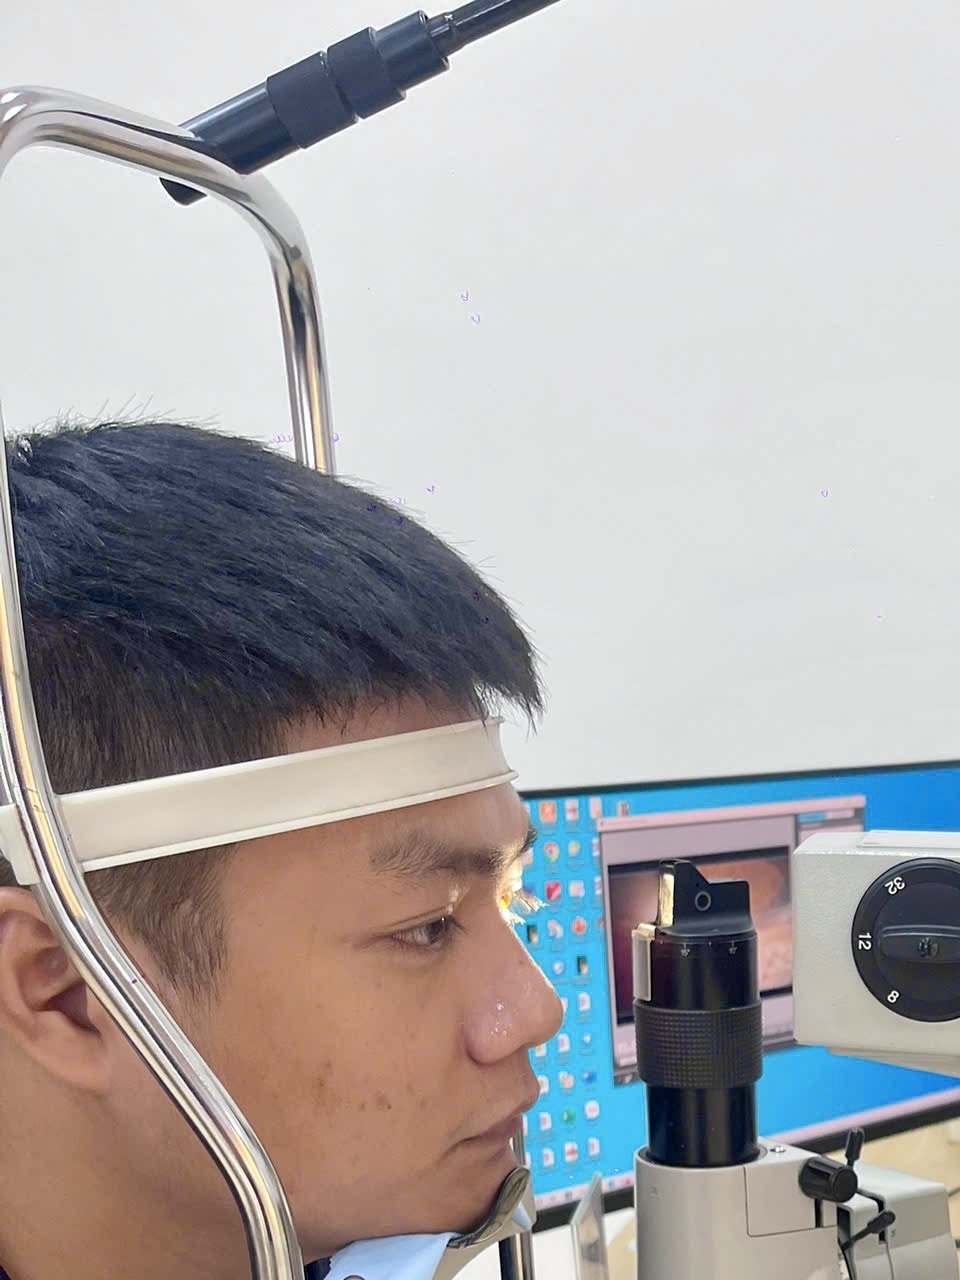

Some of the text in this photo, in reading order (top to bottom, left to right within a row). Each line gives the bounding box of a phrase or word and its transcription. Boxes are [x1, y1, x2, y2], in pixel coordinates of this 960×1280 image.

[885, 876, 905, 895] 32
[858, 932, 872, 950] 12
[887, 990, 900, 1003] 8
